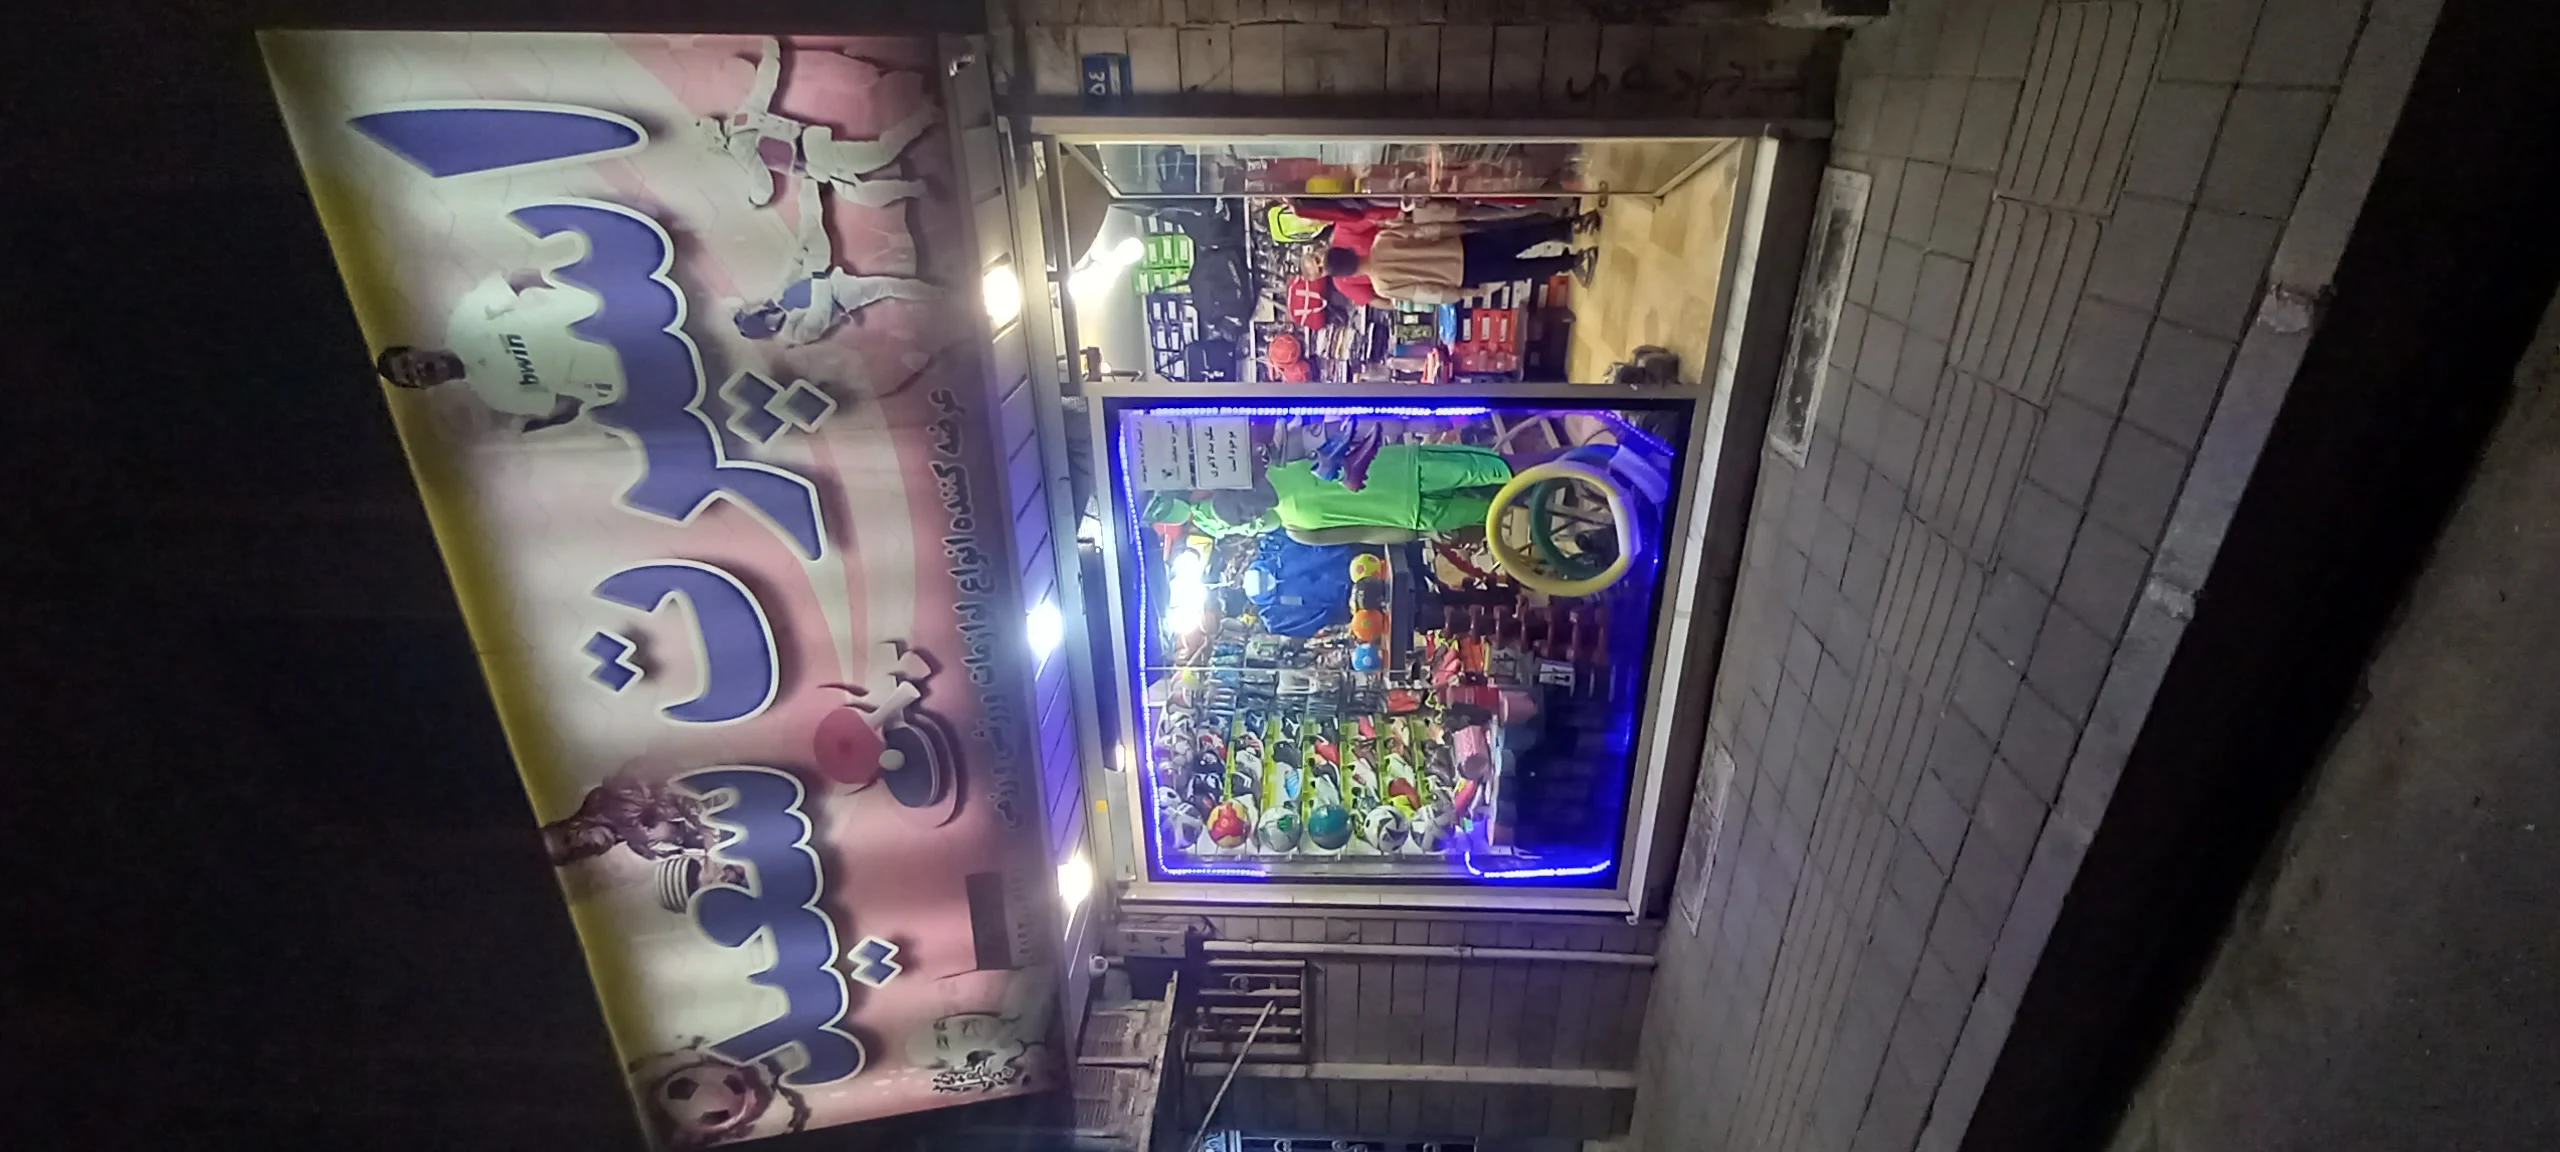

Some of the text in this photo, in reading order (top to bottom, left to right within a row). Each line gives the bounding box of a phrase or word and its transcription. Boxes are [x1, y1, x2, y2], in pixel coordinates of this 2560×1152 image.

[503, 333, 540, 386] bwin
[925, 388, 967, 454] عرضه
[1227, 431, 1238, 472] موجود است
[929, 460, 976, 533] کننده
[343, 101, 902, 1086] اسپرت سعید
[942, 534, 996, 596] انواع
[953, 601, 998, 687] لوازمات
[970, 693, 1015, 760] ورزشی
